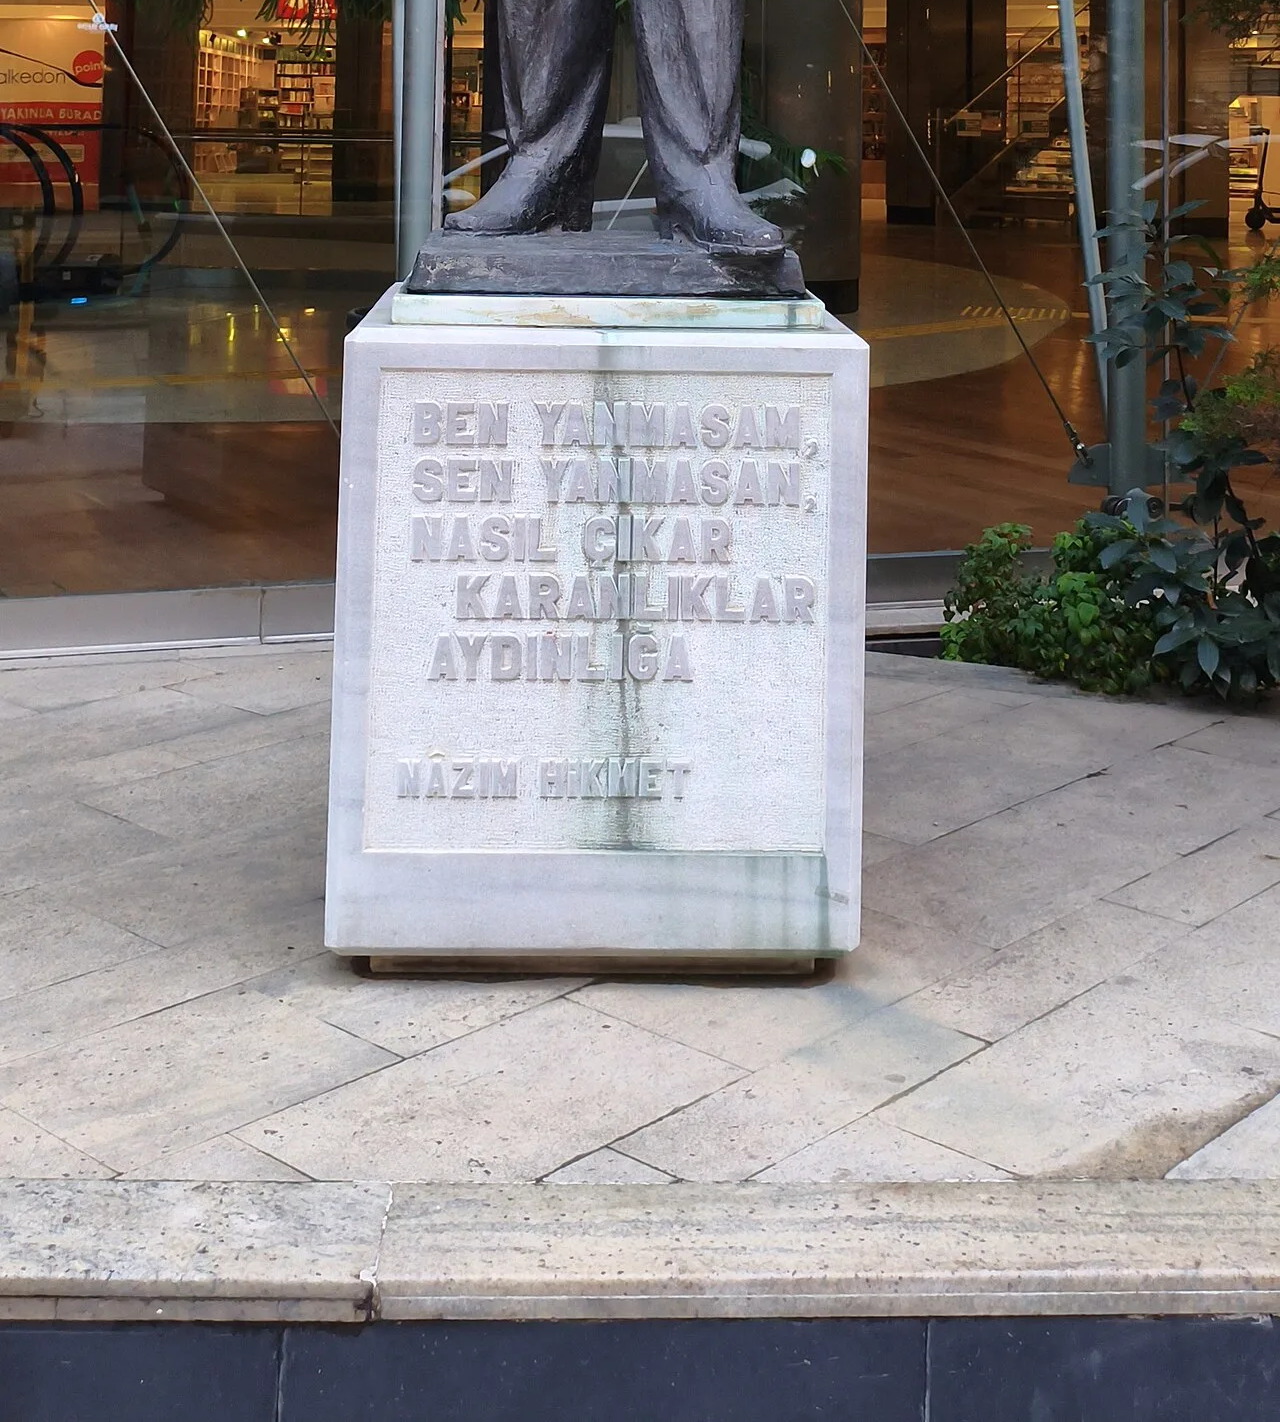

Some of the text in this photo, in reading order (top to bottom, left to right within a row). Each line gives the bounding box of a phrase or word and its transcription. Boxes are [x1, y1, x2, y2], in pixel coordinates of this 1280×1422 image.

[413, 400, 820, 459] BEN YANMASAM,
[412, 456, 818, 512] SEN YANMASAN,
[411, 514, 731, 571] NASIL ÇIKAR
[454, 571, 816, 624] KARANLIKLAR
[426, 622, 694, 682] AYDINLIĞA
[397, 749, 519, 799] NÂZIM
